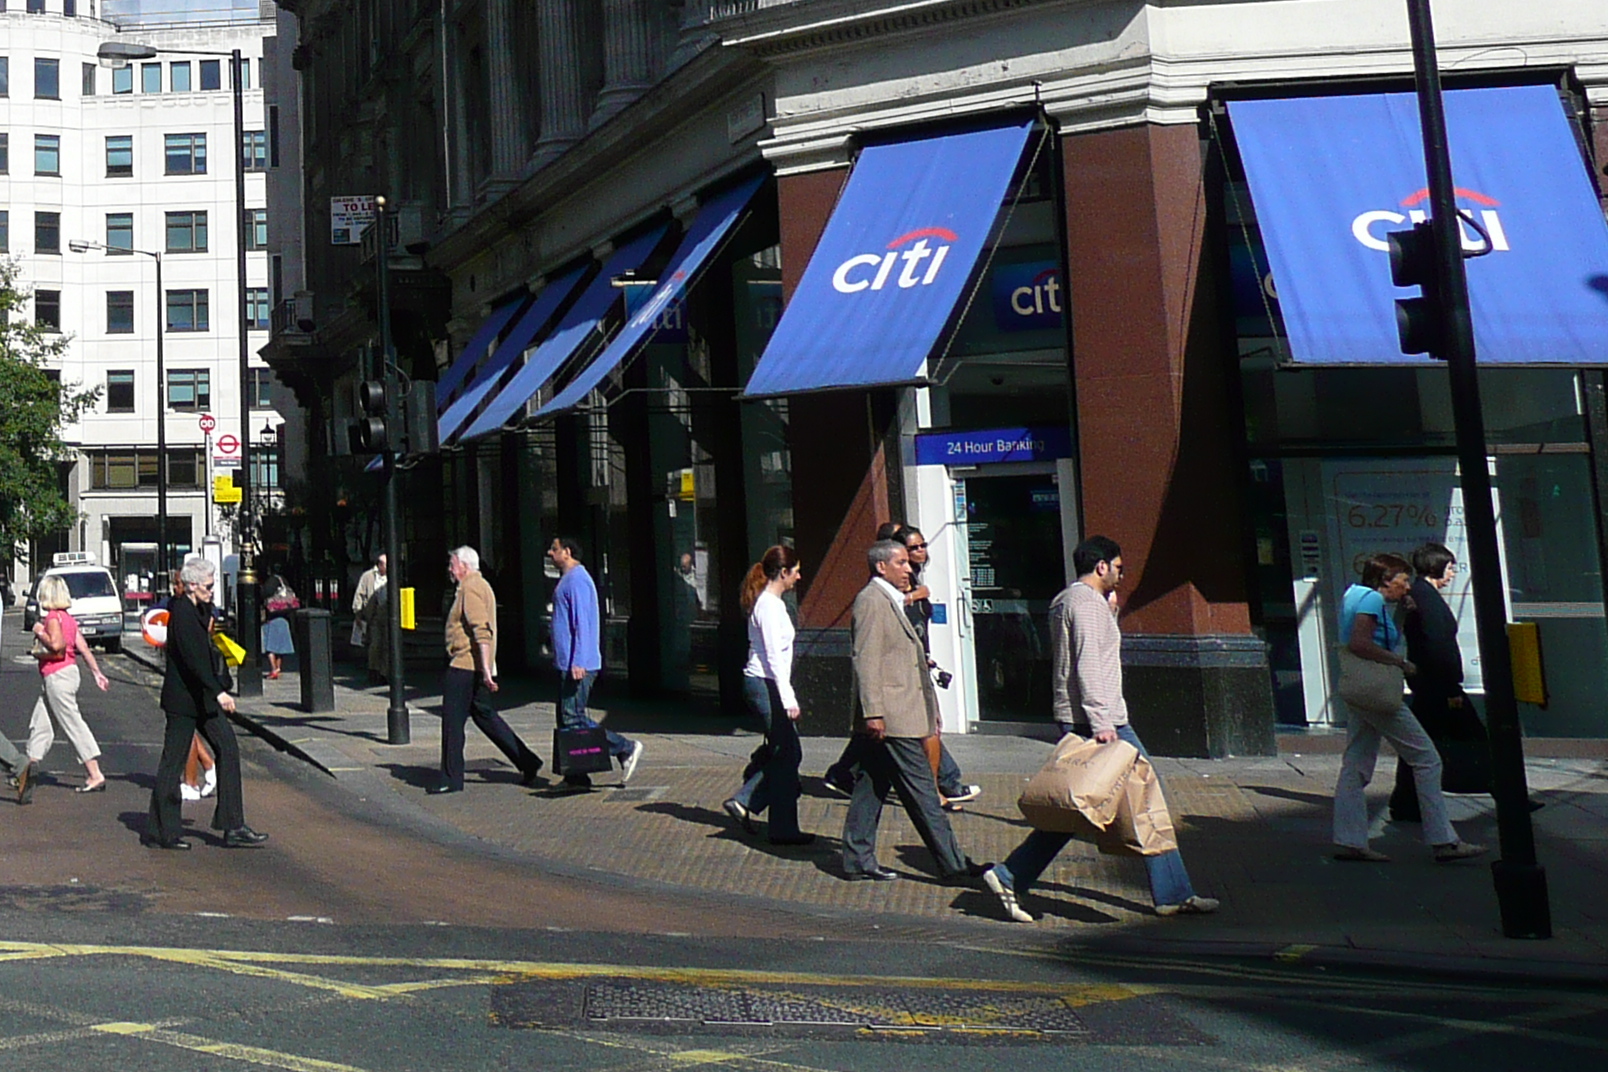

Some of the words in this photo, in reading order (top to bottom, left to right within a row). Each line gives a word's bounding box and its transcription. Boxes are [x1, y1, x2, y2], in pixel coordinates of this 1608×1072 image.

[343, 203, 358, 211] TO
[361, 202, 374, 211] LE
[832, 238, 951, 294] citi
[1011, 276, 1061, 316] cit
[947, 442, 962, 455] 24
[965, 441, 994, 453] Hour
[996, 438, 1045, 453] Banking
[1347, 504, 1438, 529] 6.27%
